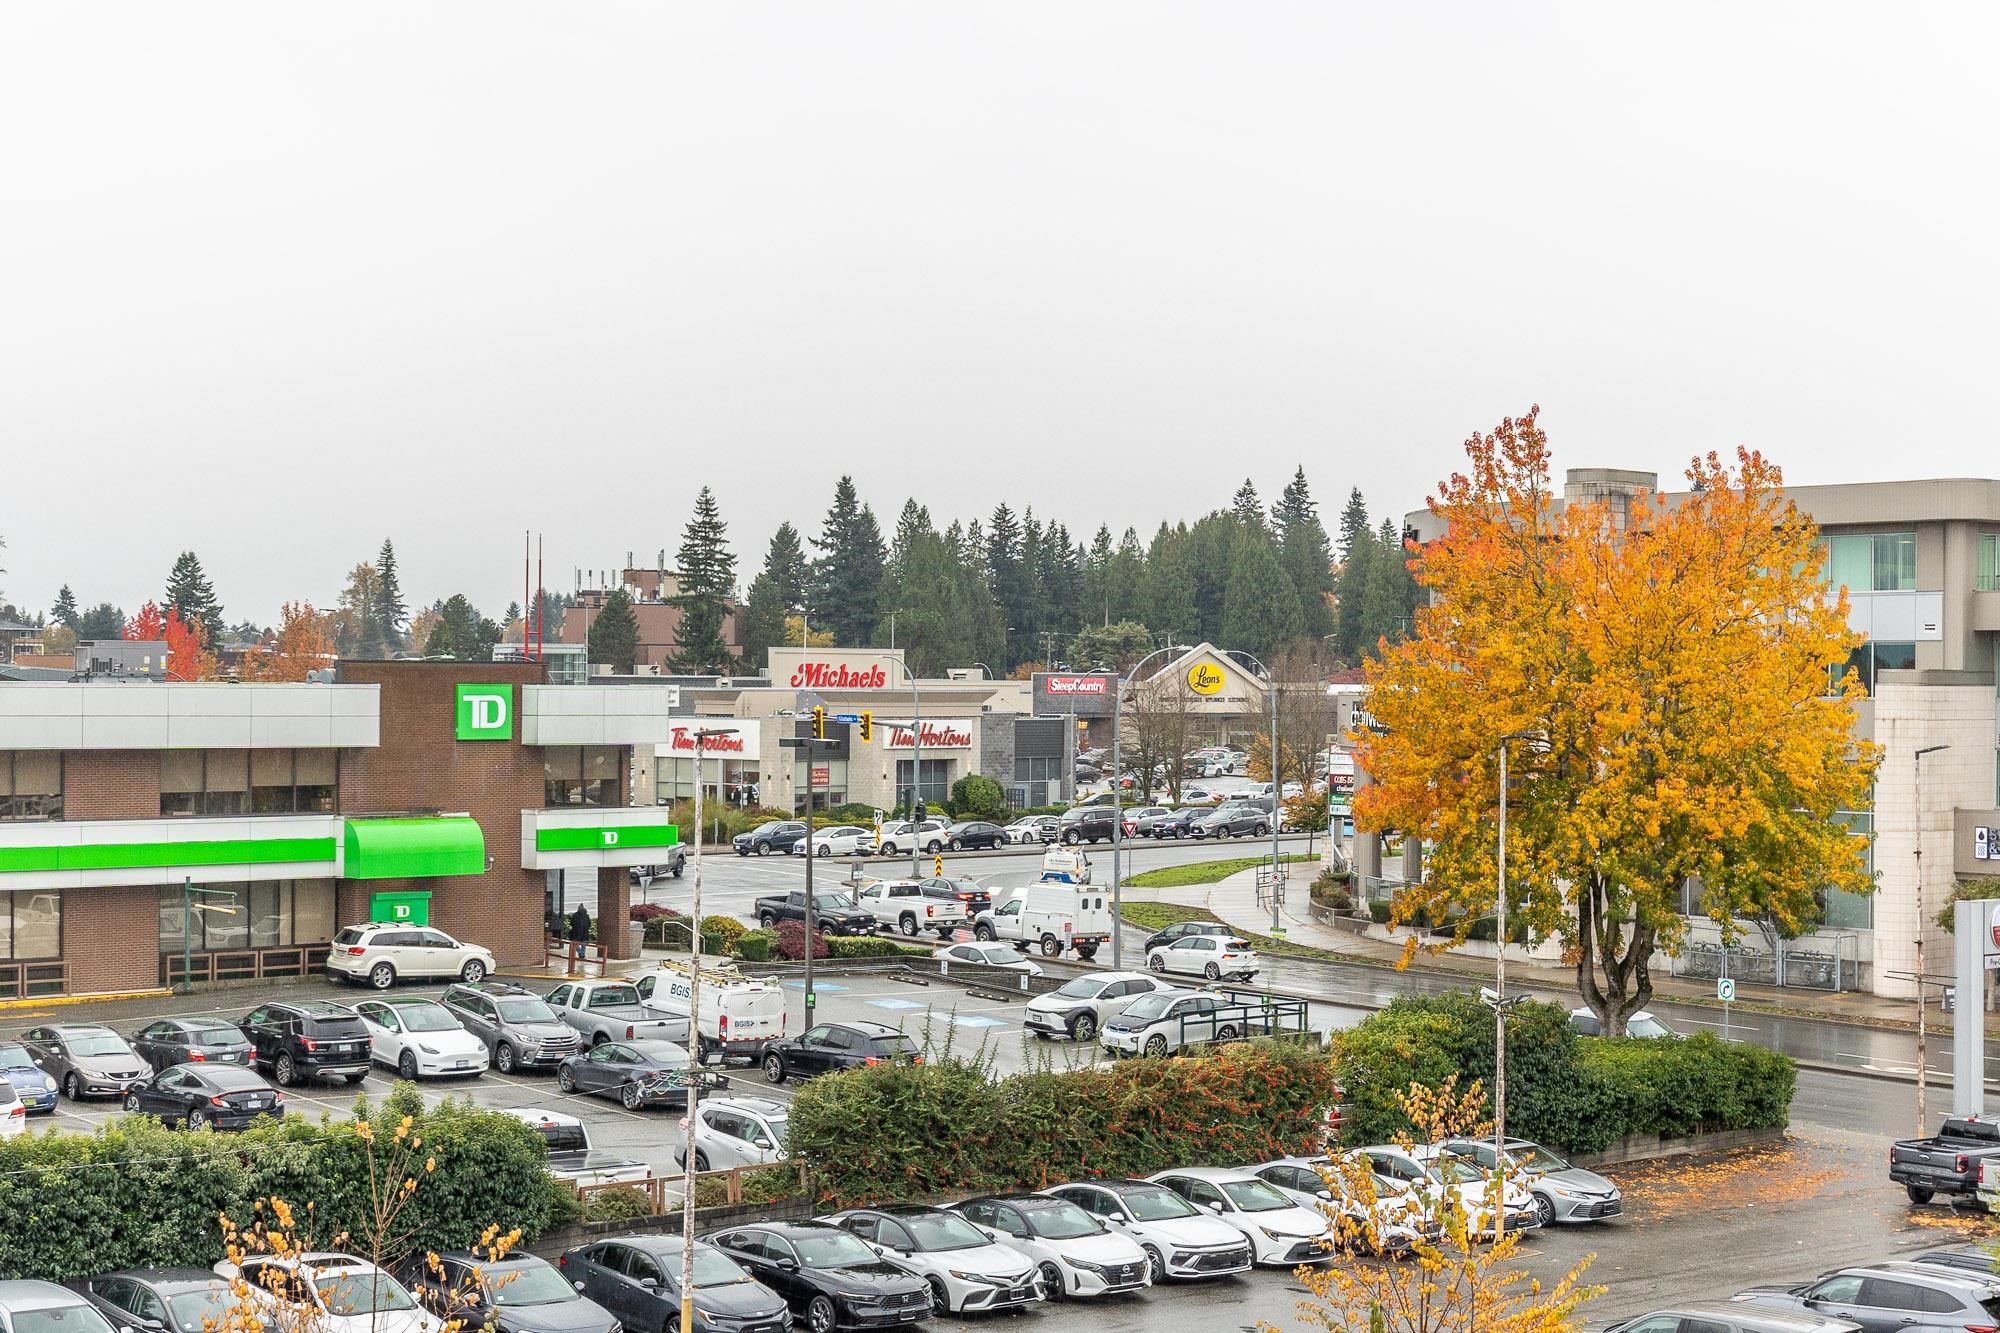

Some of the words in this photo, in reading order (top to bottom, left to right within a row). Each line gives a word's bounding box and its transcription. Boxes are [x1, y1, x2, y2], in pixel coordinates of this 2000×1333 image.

[791, 664, 886, 688] Michaels
[1194, 666, 1220, 688] Leon's
[463, 695, 507, 729] TD
[671, 727, 694, 750] Tim
[890, 725, 915, 747] Tim
[917, 722, 972, 747] Hortons
[602, 832, 618, 845] TD
[394, 905, 410, 918] TD
[671, 984, 690, 998] BGIS
[734, 1020, 750, 1028] BGIS
